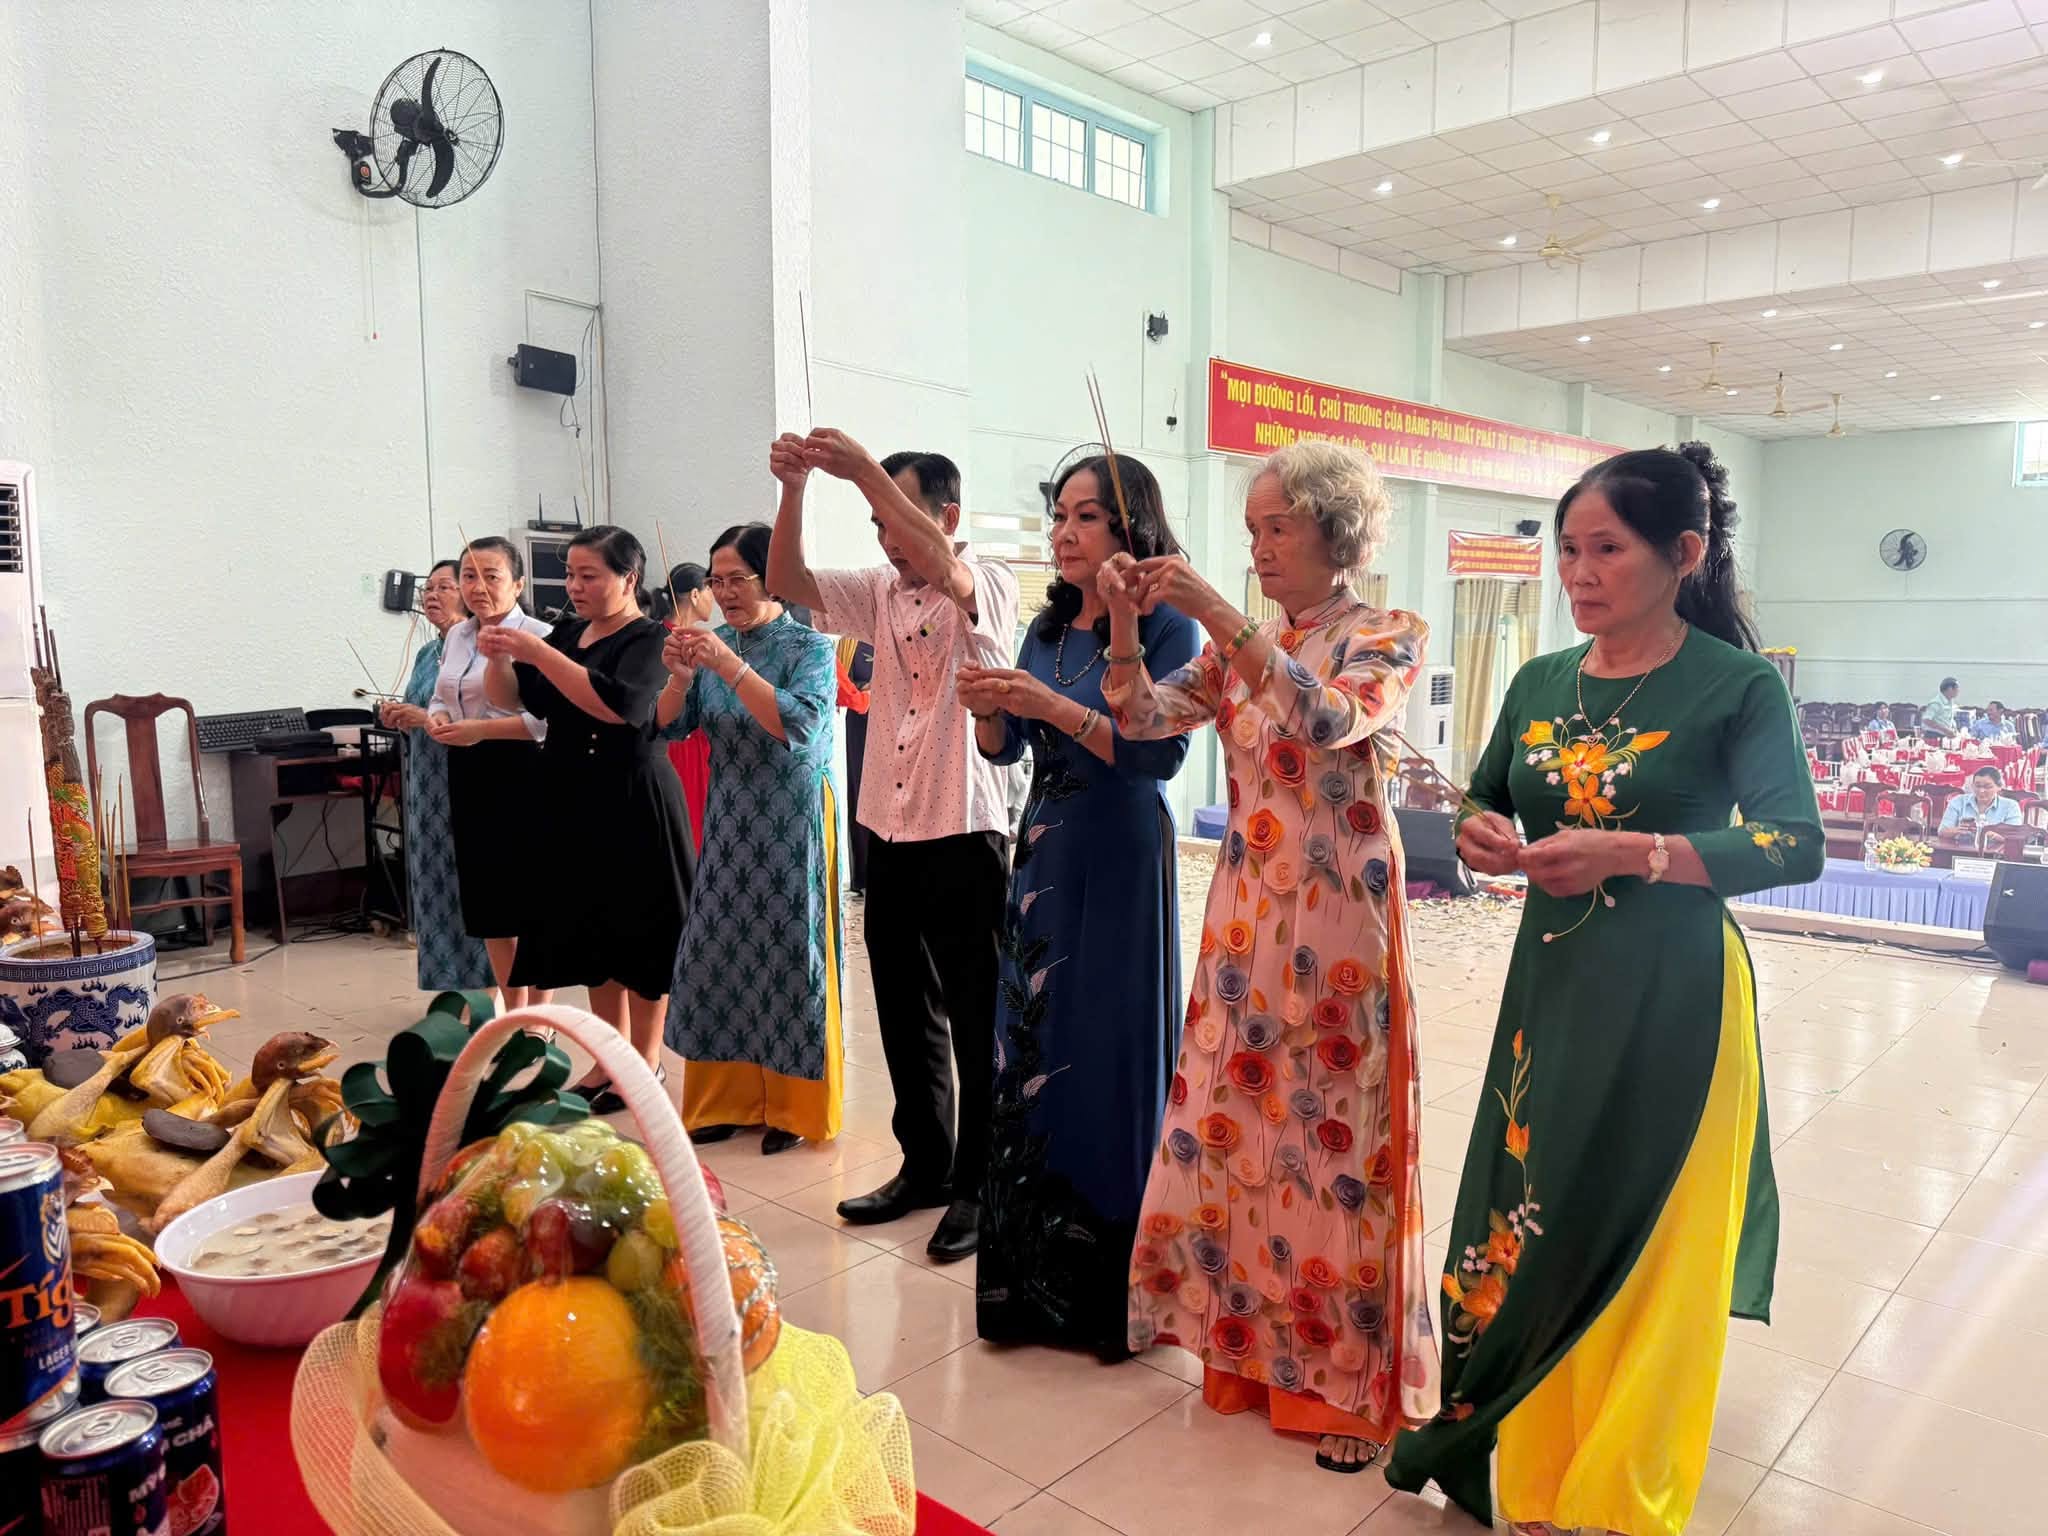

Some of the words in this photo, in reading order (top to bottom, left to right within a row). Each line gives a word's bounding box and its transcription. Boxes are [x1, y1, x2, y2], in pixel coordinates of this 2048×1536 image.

[1255, 382, 1294, 412] ĐƯỜNG
[1296, 387, 1317, 418] LỐI,
[1319, 393, 1340, 420] CHỦ
[1343, 401, 1382, 428] TRƯƠNG
[1384, 405, 1403, 431] CỦA
[1405, 409, 1431, 438] ĐẢNG
[1431, 416, 1452, 441] PHẢI
[1255, 421, 1295, 447] NHỮNG
